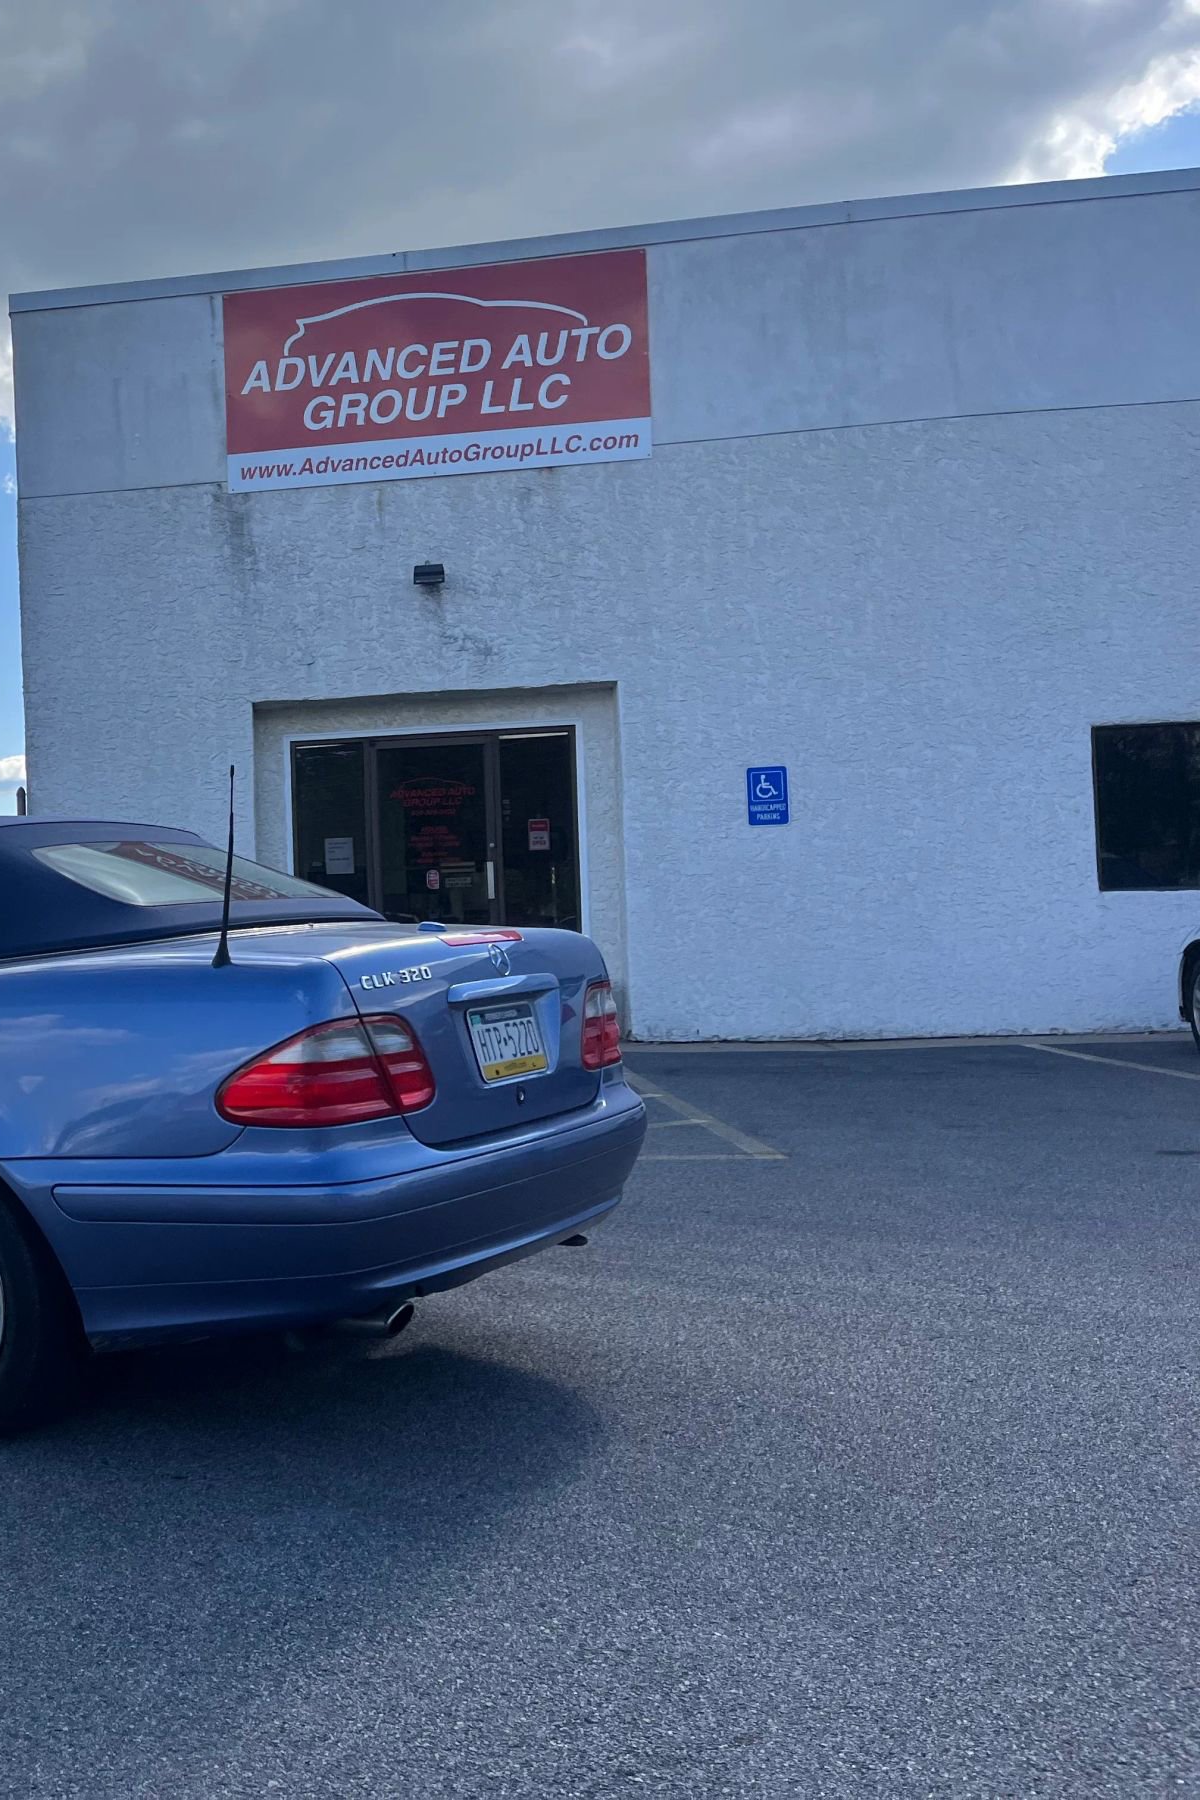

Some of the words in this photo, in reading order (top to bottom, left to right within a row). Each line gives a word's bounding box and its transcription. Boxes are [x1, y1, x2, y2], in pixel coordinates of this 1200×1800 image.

[241, 339, 491, 395] ADVANCED
[501, 324, 632, 369] AUTO
[303, 384, 467, 431] GROUP
[480, 374, 571, 415] LLC
[240, 432, 639, 480] www.AdvancedAutoGroupLLC.com
[750, 803, 786, 812] HANDICAPPED
[757, 812, 781, 820] PARKING
[361, 971, 395, 990] CLK
[399, 966, 432, 983] 320
